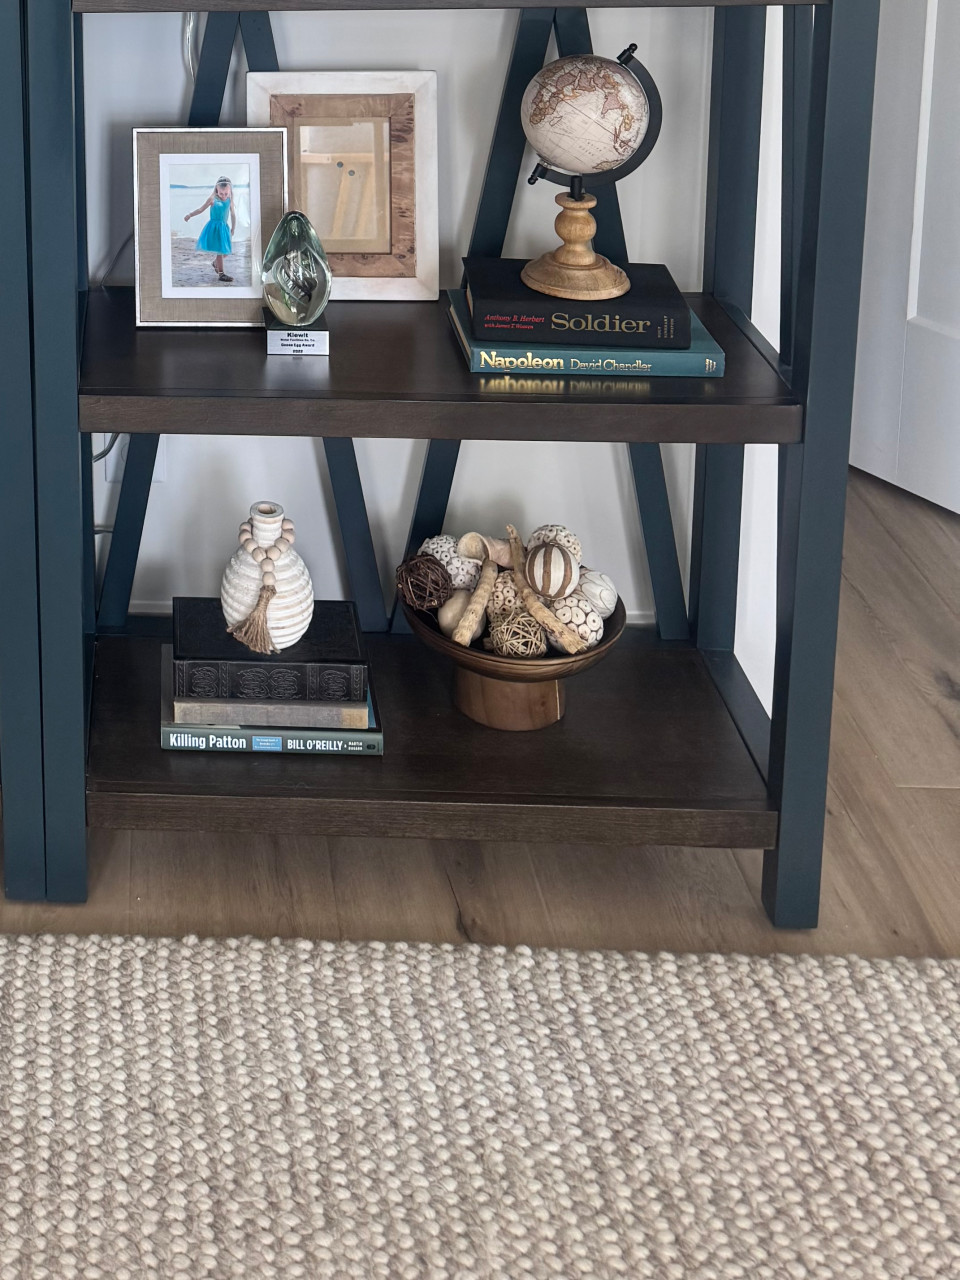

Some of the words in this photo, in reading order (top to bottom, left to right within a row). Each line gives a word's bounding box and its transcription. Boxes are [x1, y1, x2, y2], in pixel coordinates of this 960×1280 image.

[552, 312, 651, 332] Soldier
[480, 351, 564, 371] Napoleon
[570, 358, 602, 370] David
[603, 360, 652, 371] Chandler
[170, 734, 206, 748] Killing
[209, 734, 246, 748] Patton
[288, 740, 304, 750] BILL
[306, 740, 342, 750] O'REILLY
